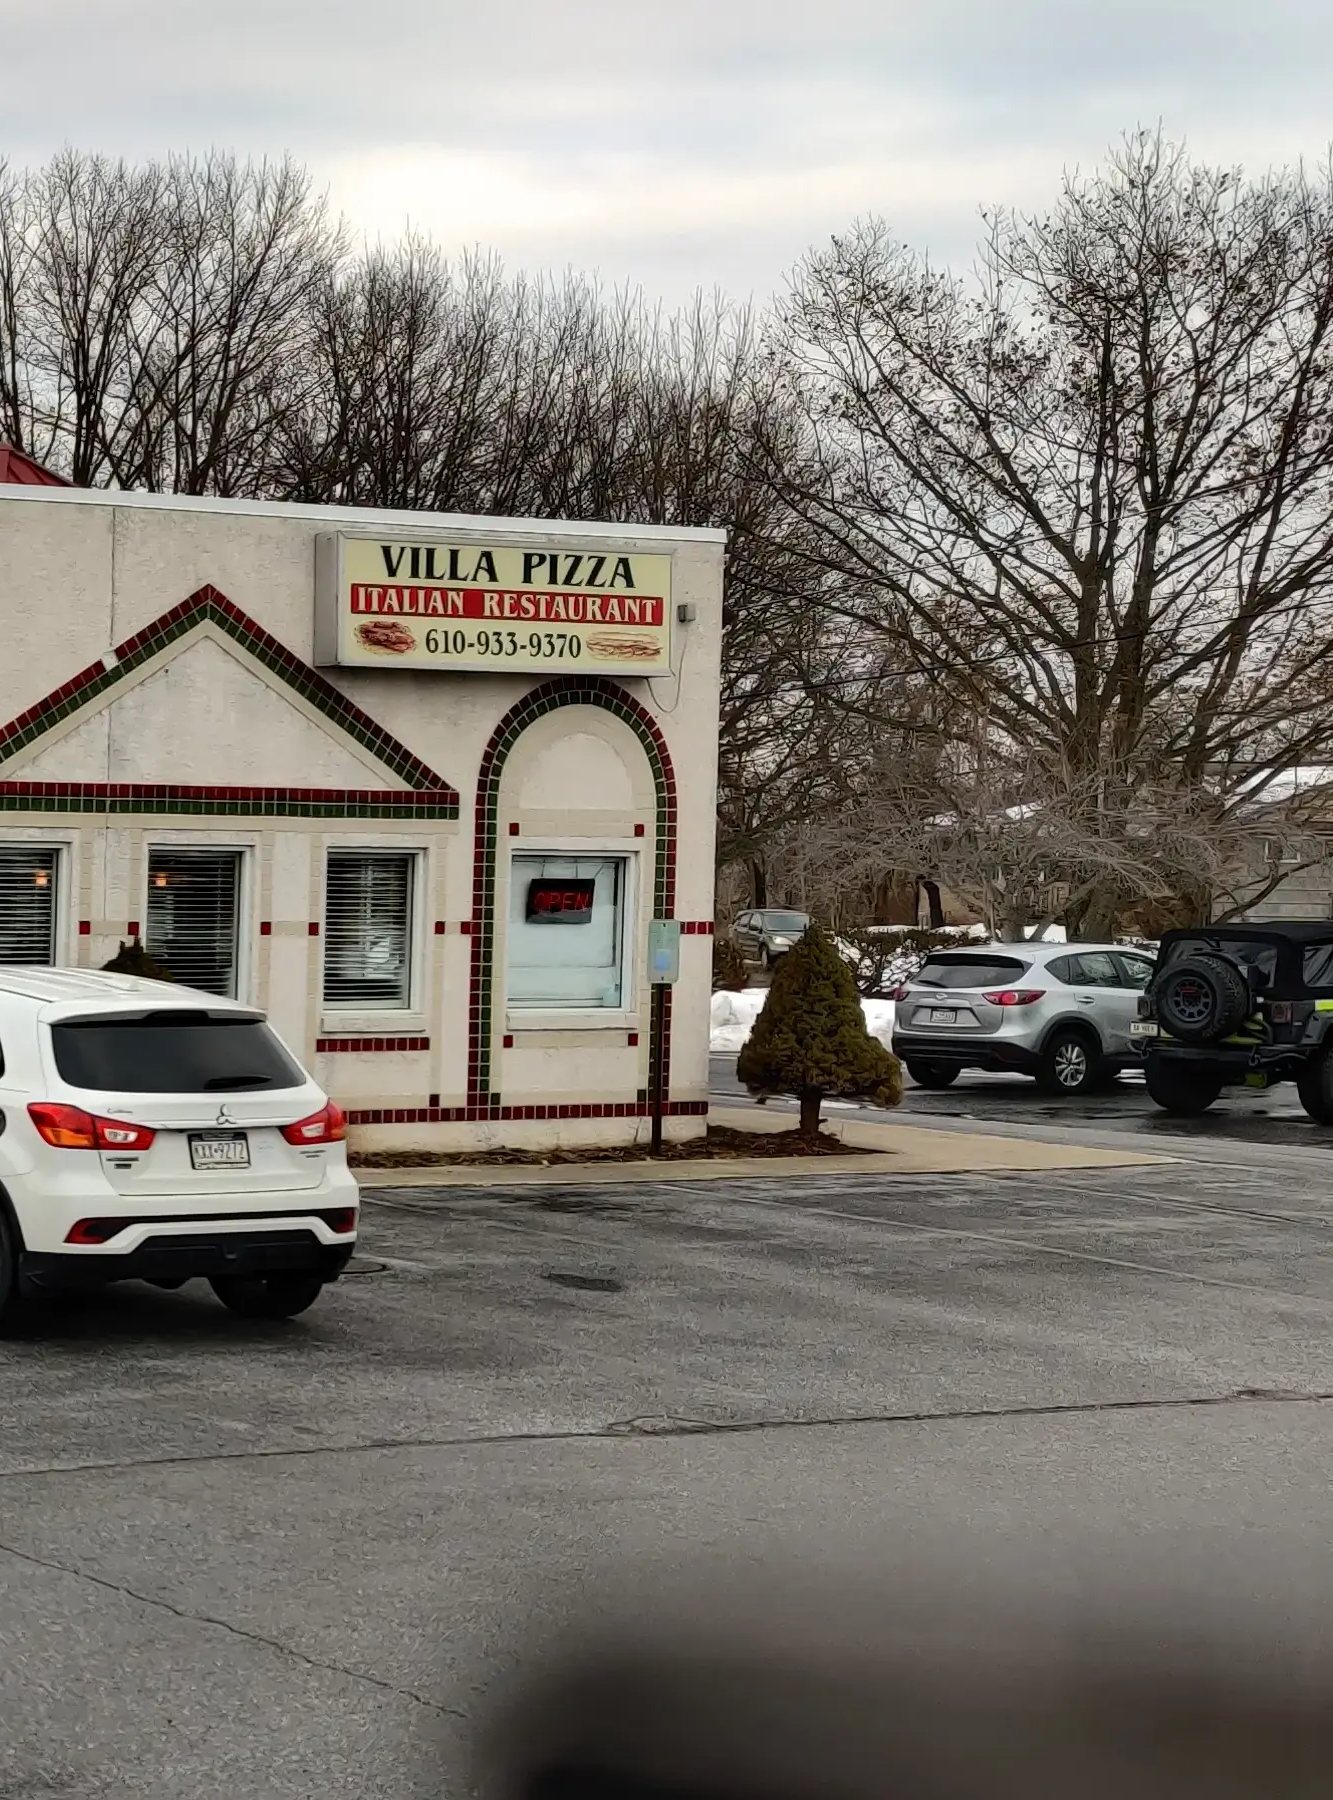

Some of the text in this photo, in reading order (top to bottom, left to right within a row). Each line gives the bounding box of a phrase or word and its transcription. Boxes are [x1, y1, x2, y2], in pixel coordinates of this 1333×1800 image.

[380, 544, 636, 589] VILLA PIZZA
[356, 586, 657, 624] ITALIAN RESTAURANT
[425, 628, 582, 659] 610-933-9370
[533, 891, 590, 912] OPEN
